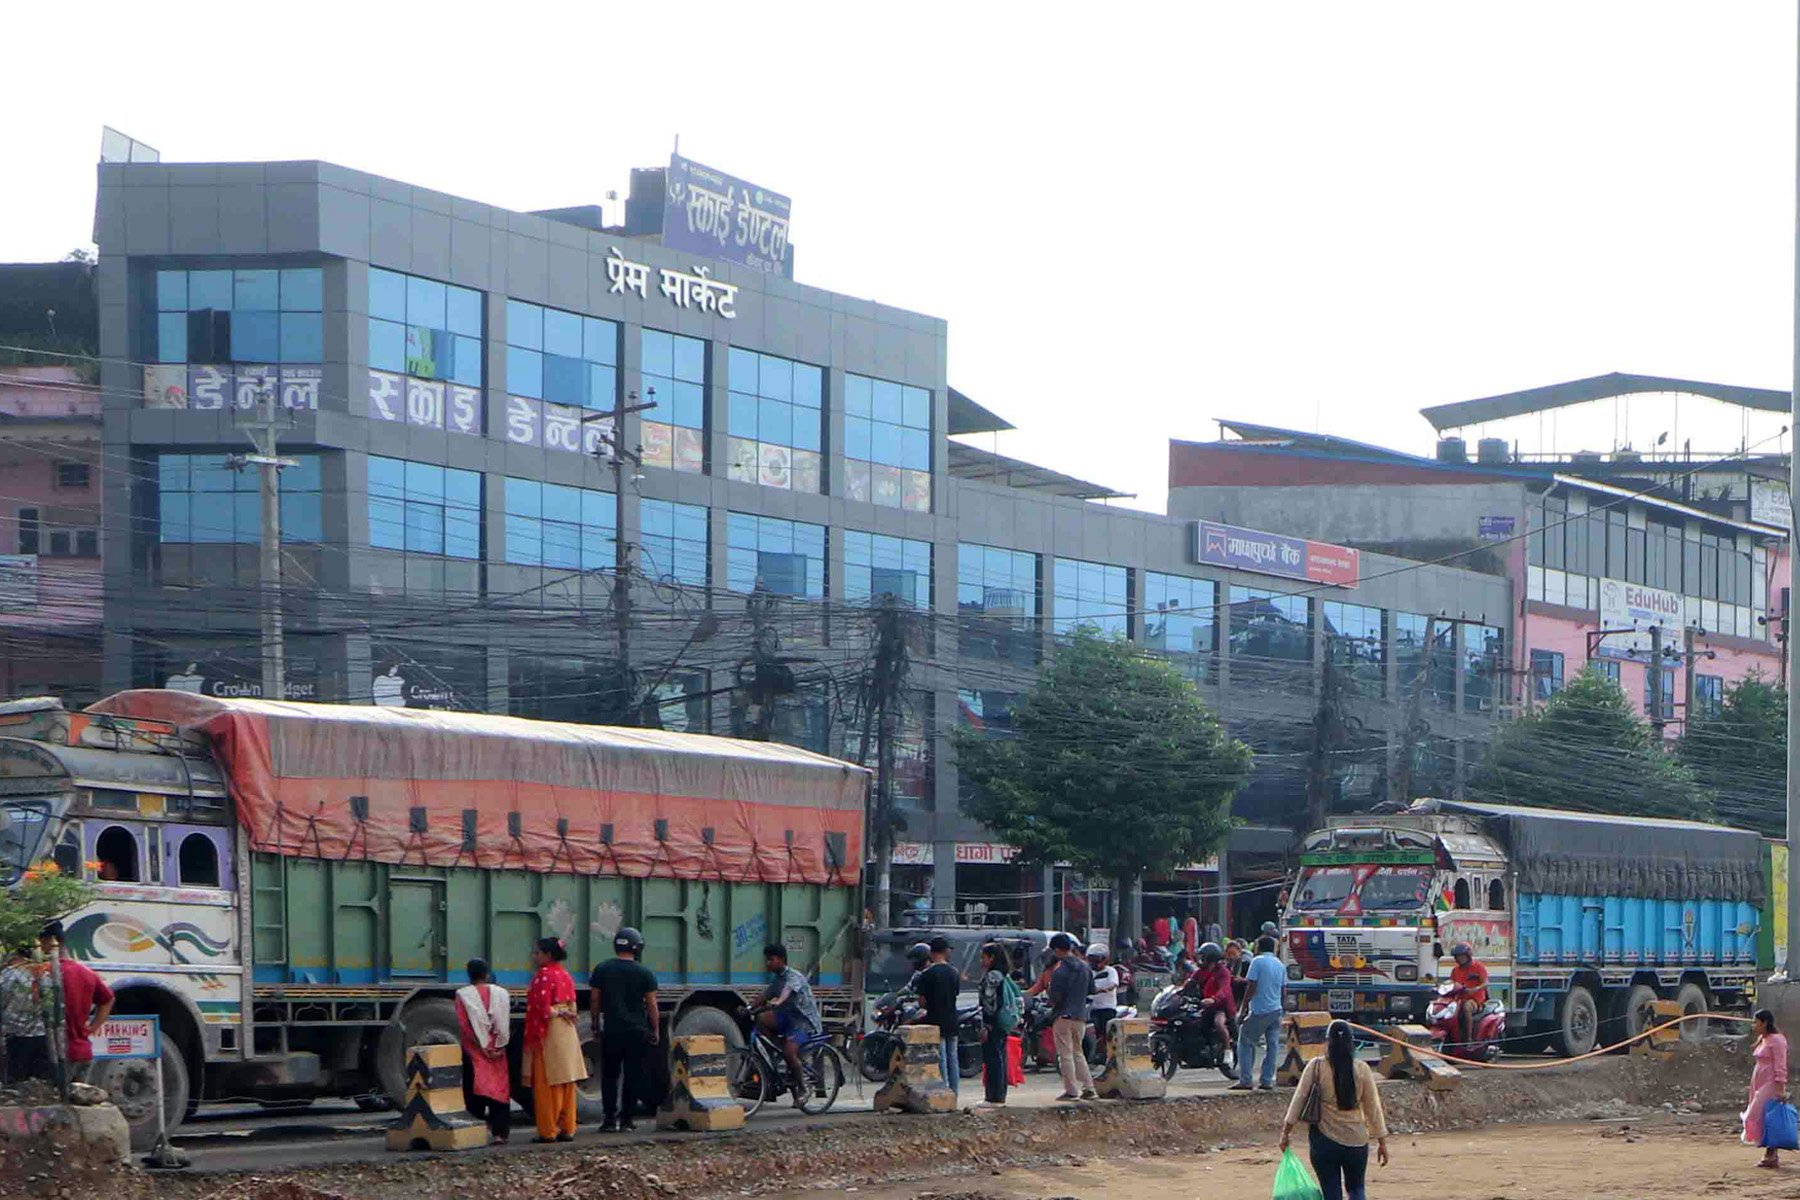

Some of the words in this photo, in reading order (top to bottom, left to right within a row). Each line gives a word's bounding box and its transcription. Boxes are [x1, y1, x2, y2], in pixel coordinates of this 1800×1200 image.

[686, 184, 734, 247] स्काई
[734, 189, 789, 261] डेण्टल
[605, 246, 649, 299] प्रेम
[658, 264, 738, 319] मार्केट
[1625, 586, 1678, 615] EduHub
[1336, 936, 1357, 945] TATA
[104, 1023, 148, 1037] PARKING
